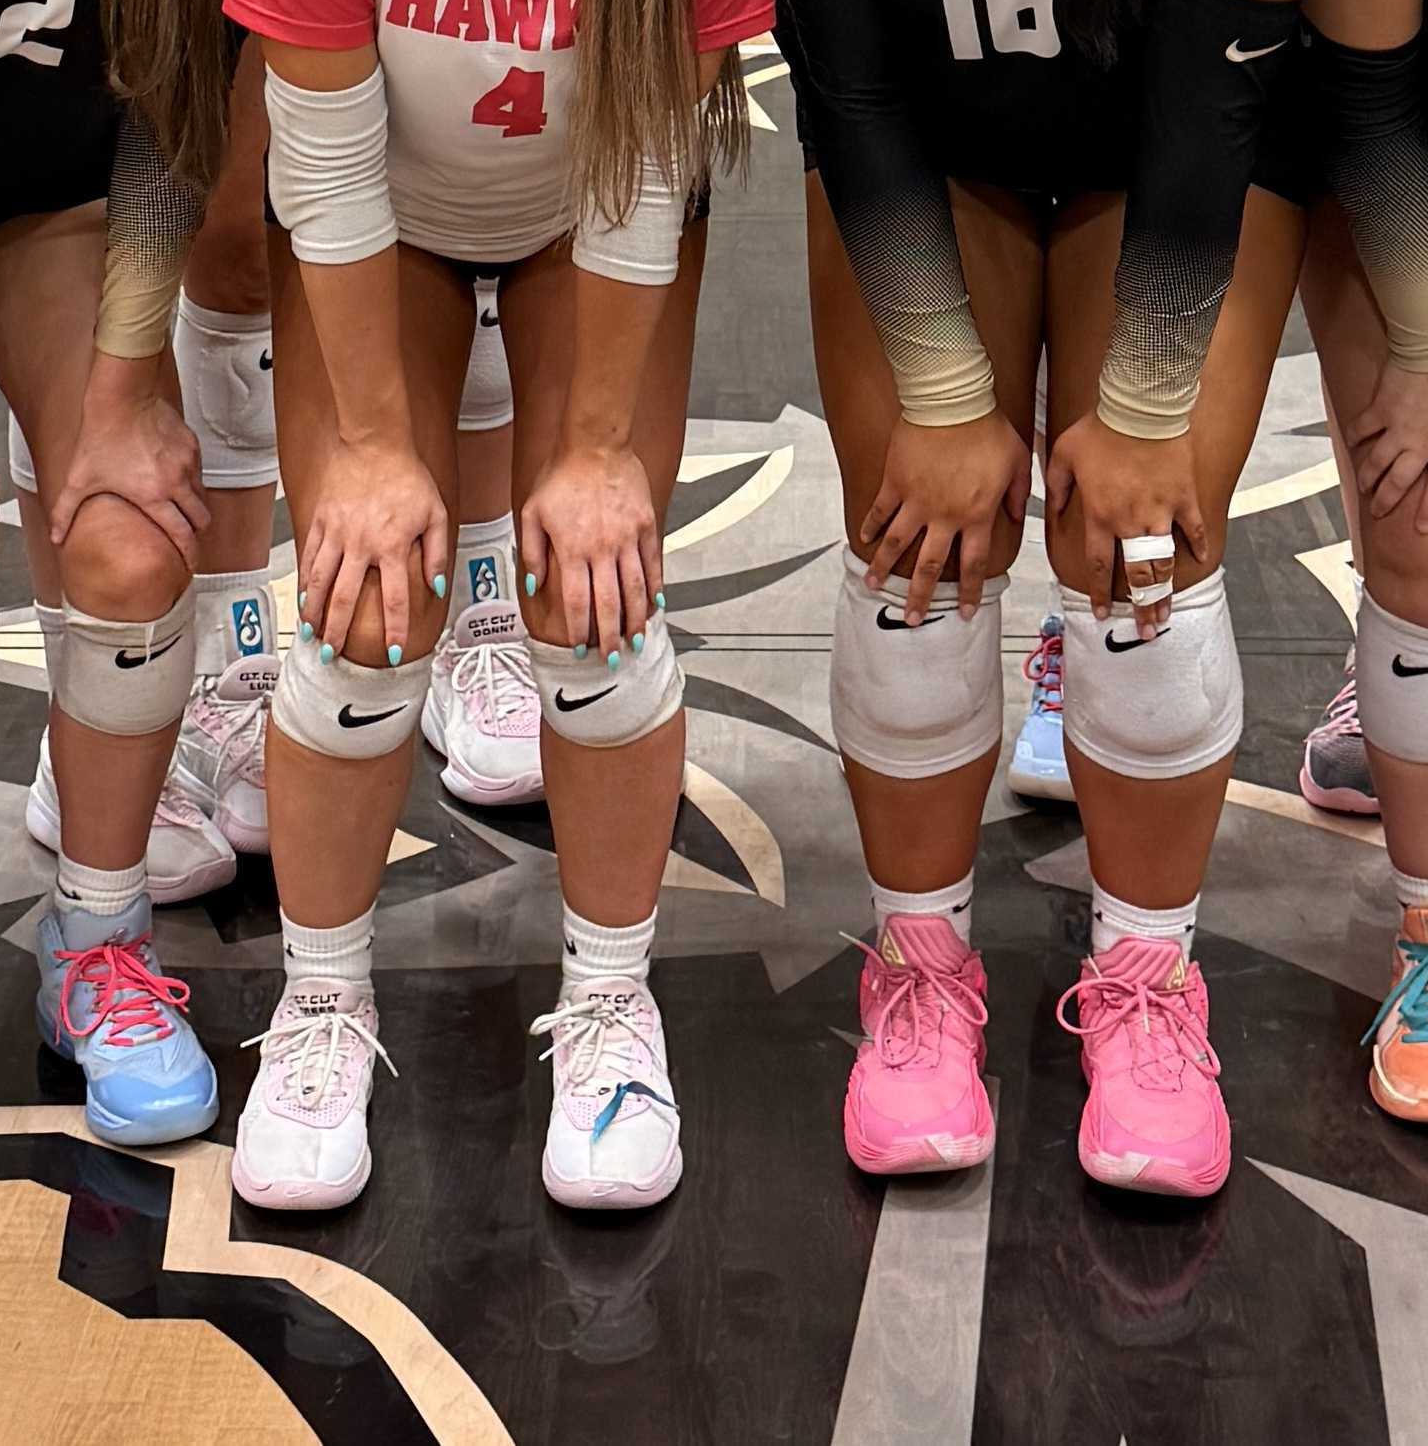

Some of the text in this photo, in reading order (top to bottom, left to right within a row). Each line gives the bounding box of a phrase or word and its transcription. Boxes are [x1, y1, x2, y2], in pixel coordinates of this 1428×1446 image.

[473, 68, 547, 138] 4
[491, 614, 516, 625] CUT
[249, 682, 275, 690] LUL
[310, 993, 342, 1004] CUT
